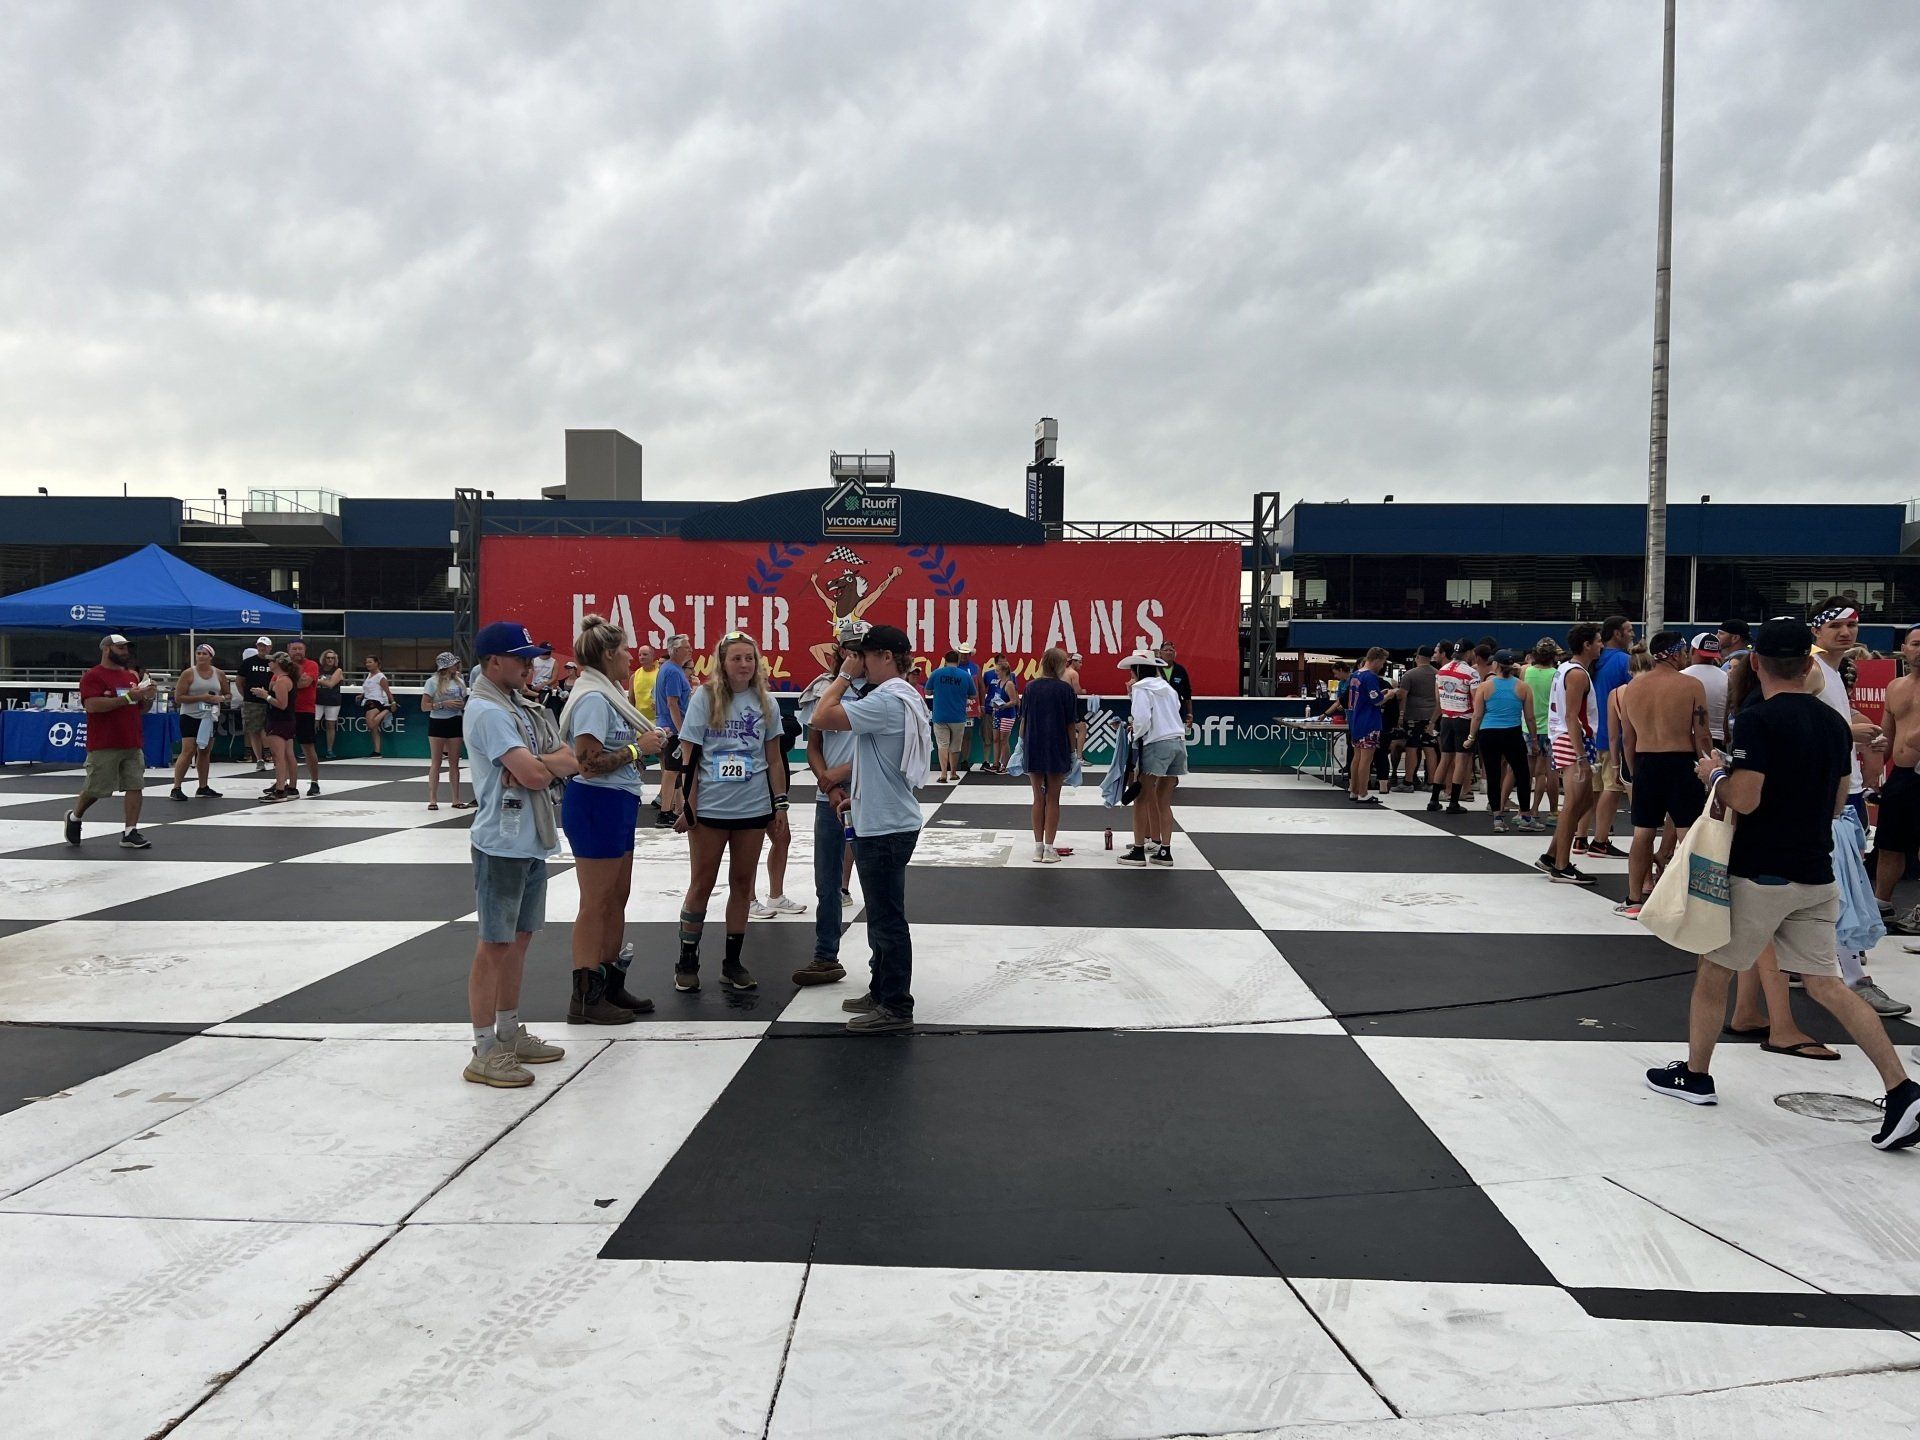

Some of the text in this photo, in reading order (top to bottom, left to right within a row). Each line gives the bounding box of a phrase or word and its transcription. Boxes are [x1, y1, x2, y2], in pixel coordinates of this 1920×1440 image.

[861, 497, 897, 509] Ruoff
[826, 517, 897, 527] VICTORY LANE
[906, 598, 1164, 655] HUMANS
[940, 674, 962, 686] CREW
[1855, 687, 1886, 700] HUMAN
[1184, 715, 1235, 746] off
[722, 765, 743, 777] 228
[1689, 880, 1730, 900] SUICID
